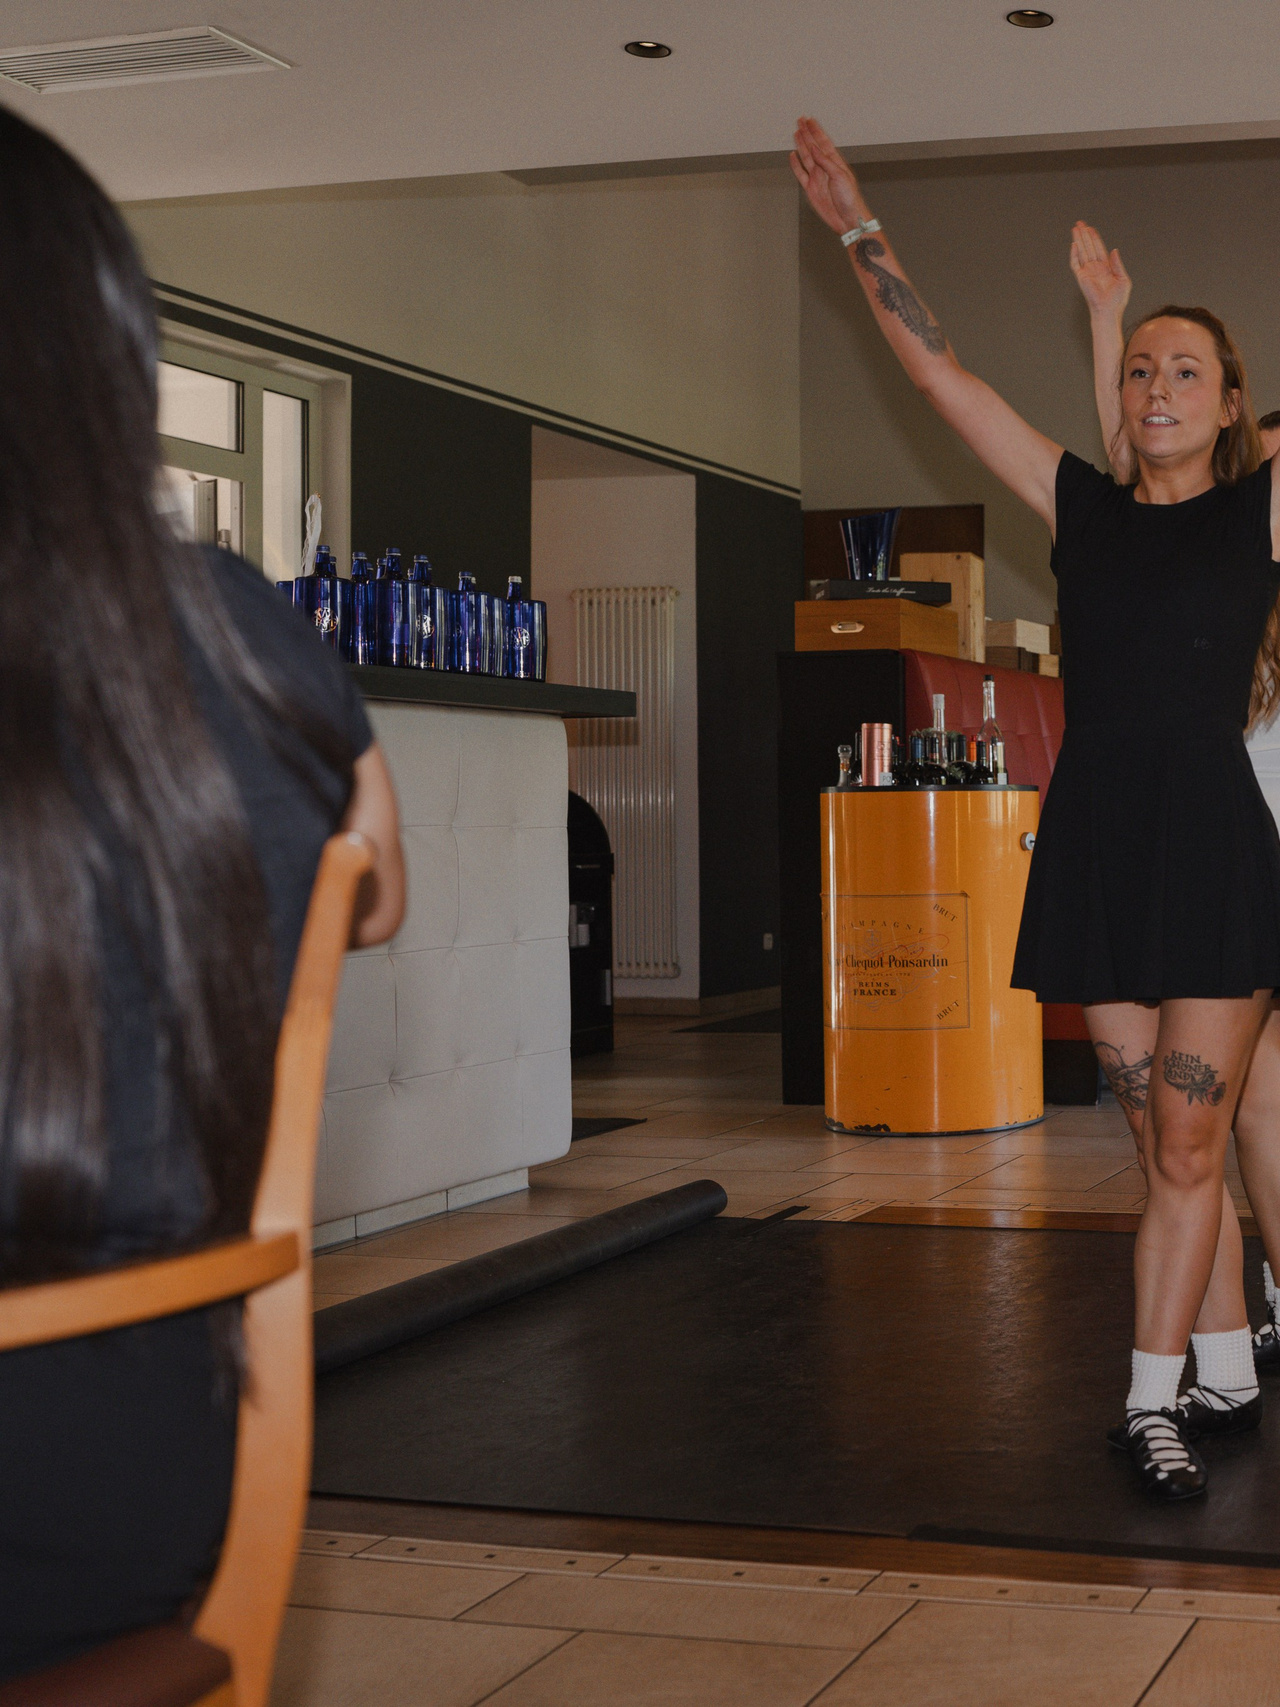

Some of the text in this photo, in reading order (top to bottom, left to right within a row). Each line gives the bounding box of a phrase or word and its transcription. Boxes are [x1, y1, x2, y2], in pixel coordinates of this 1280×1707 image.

[932, 903, 958, 922] BRUT
[888, 953, 949, 969] Ponsardin
[853, 988, 897, 996] FRANCE
[936, 999, 960, 1020] BRUT
[1171, 1049, 1201, 1064] KEIN
